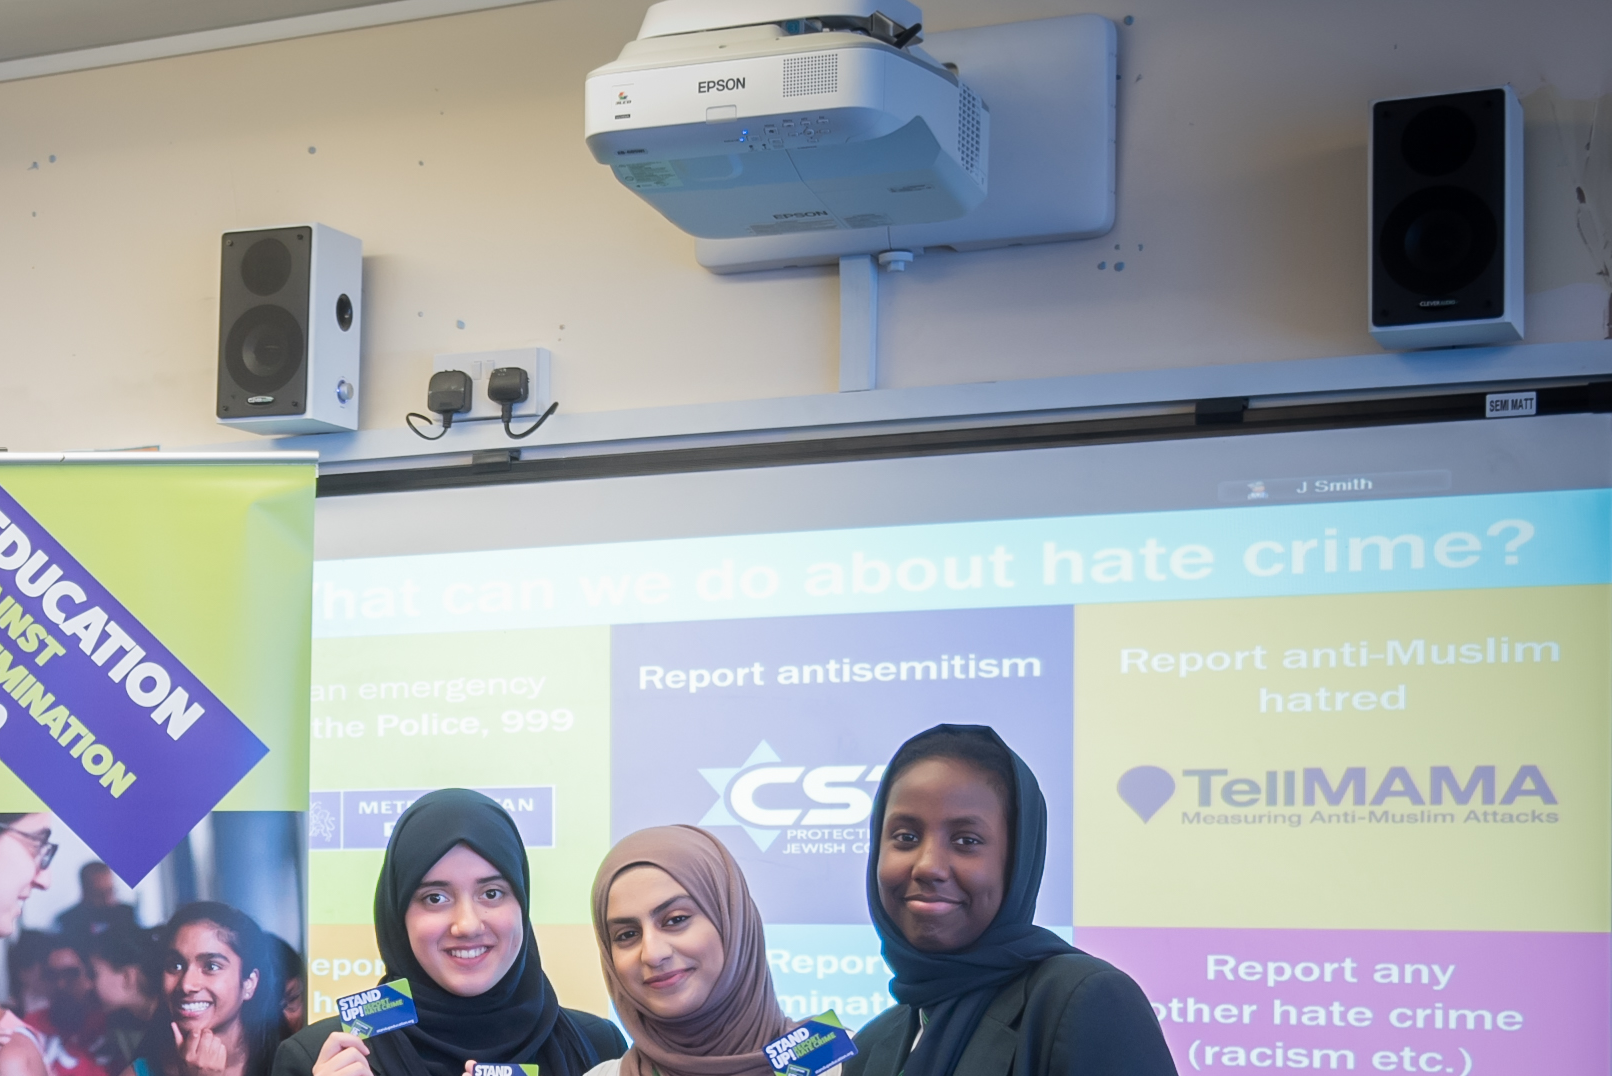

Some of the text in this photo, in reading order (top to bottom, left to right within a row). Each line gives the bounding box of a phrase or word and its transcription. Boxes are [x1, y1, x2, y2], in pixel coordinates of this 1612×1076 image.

[697, 76, 746, 101] EPSON
[772, 208, 829, 222] EPSON
[1489, 397, 1534, 413] SEMI MATT
[1296, 475, 1374, 494] J Smith
[313, 518, 1536, 622] hat can we do about hate crime?
[638, 650, 1043, 694] Report antisemitism
[1119, 636, 1562, 680] Report anti-Muslim
[310, 674, 547, 704] an emergency
[1258, 684, 1408, 714] hatred
[310, 706, 577, 740] the Police, 999
[1182, 764, 1559, 808] TellMAMA
[1181, 808, 1560, 829] Measuring Anti-Muslim Attacks
[782, 842, 847, 855] JEWISH
[1206, 955, 1456, 991] Report any
[338, 989, 382, 1011] STAND
[341, 1004, 365, 1022] UP!
[1151, 997, 1524, 1032] other hate crime
[765, 1027, 810, 1059] STAND
[1188, 1040, 1356, 1072] (racism
[770, 1048, 797, 1070] UP!
